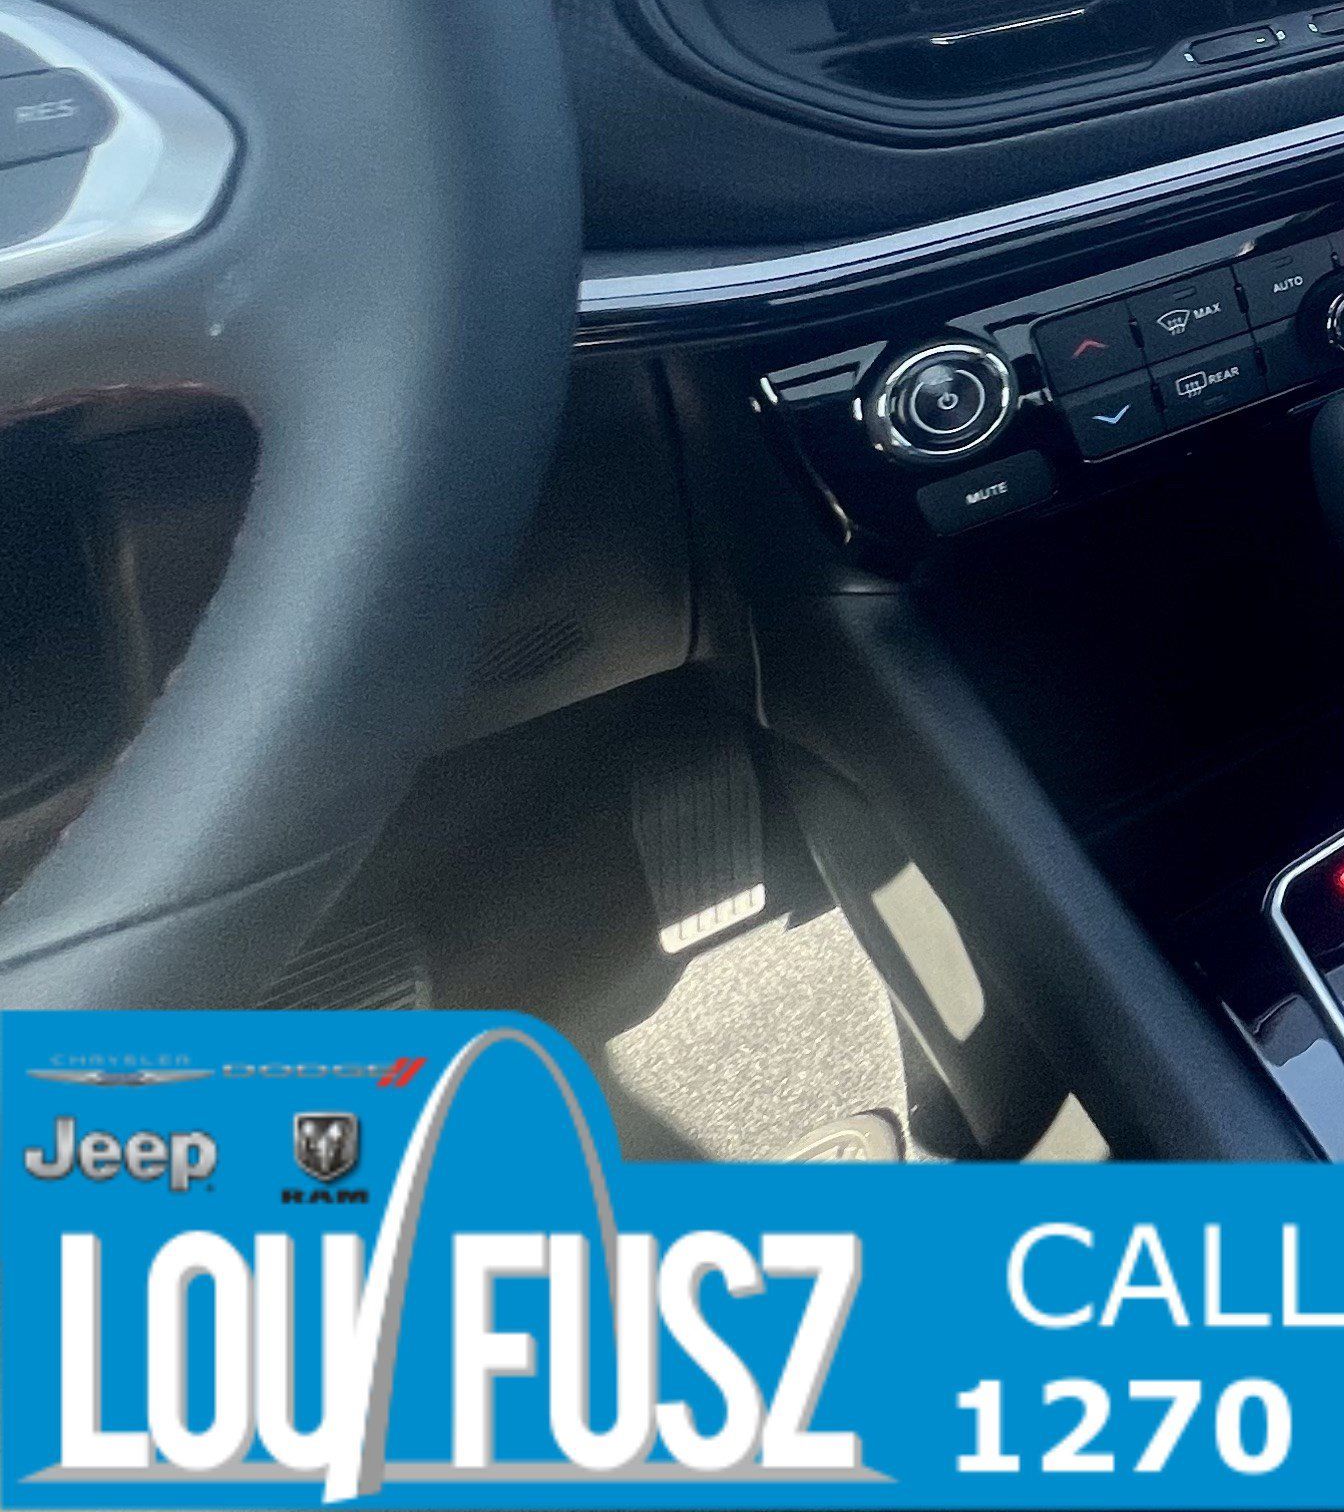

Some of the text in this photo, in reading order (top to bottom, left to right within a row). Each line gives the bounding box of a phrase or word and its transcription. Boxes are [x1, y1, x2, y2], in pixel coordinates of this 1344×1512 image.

[1272, 275, 1304, 294] AUTO
[1192, 302, 1222, 321] MAX
[1207, 365, 1240, 386] REAR
[965, 480, 1009, 506] MUTE
